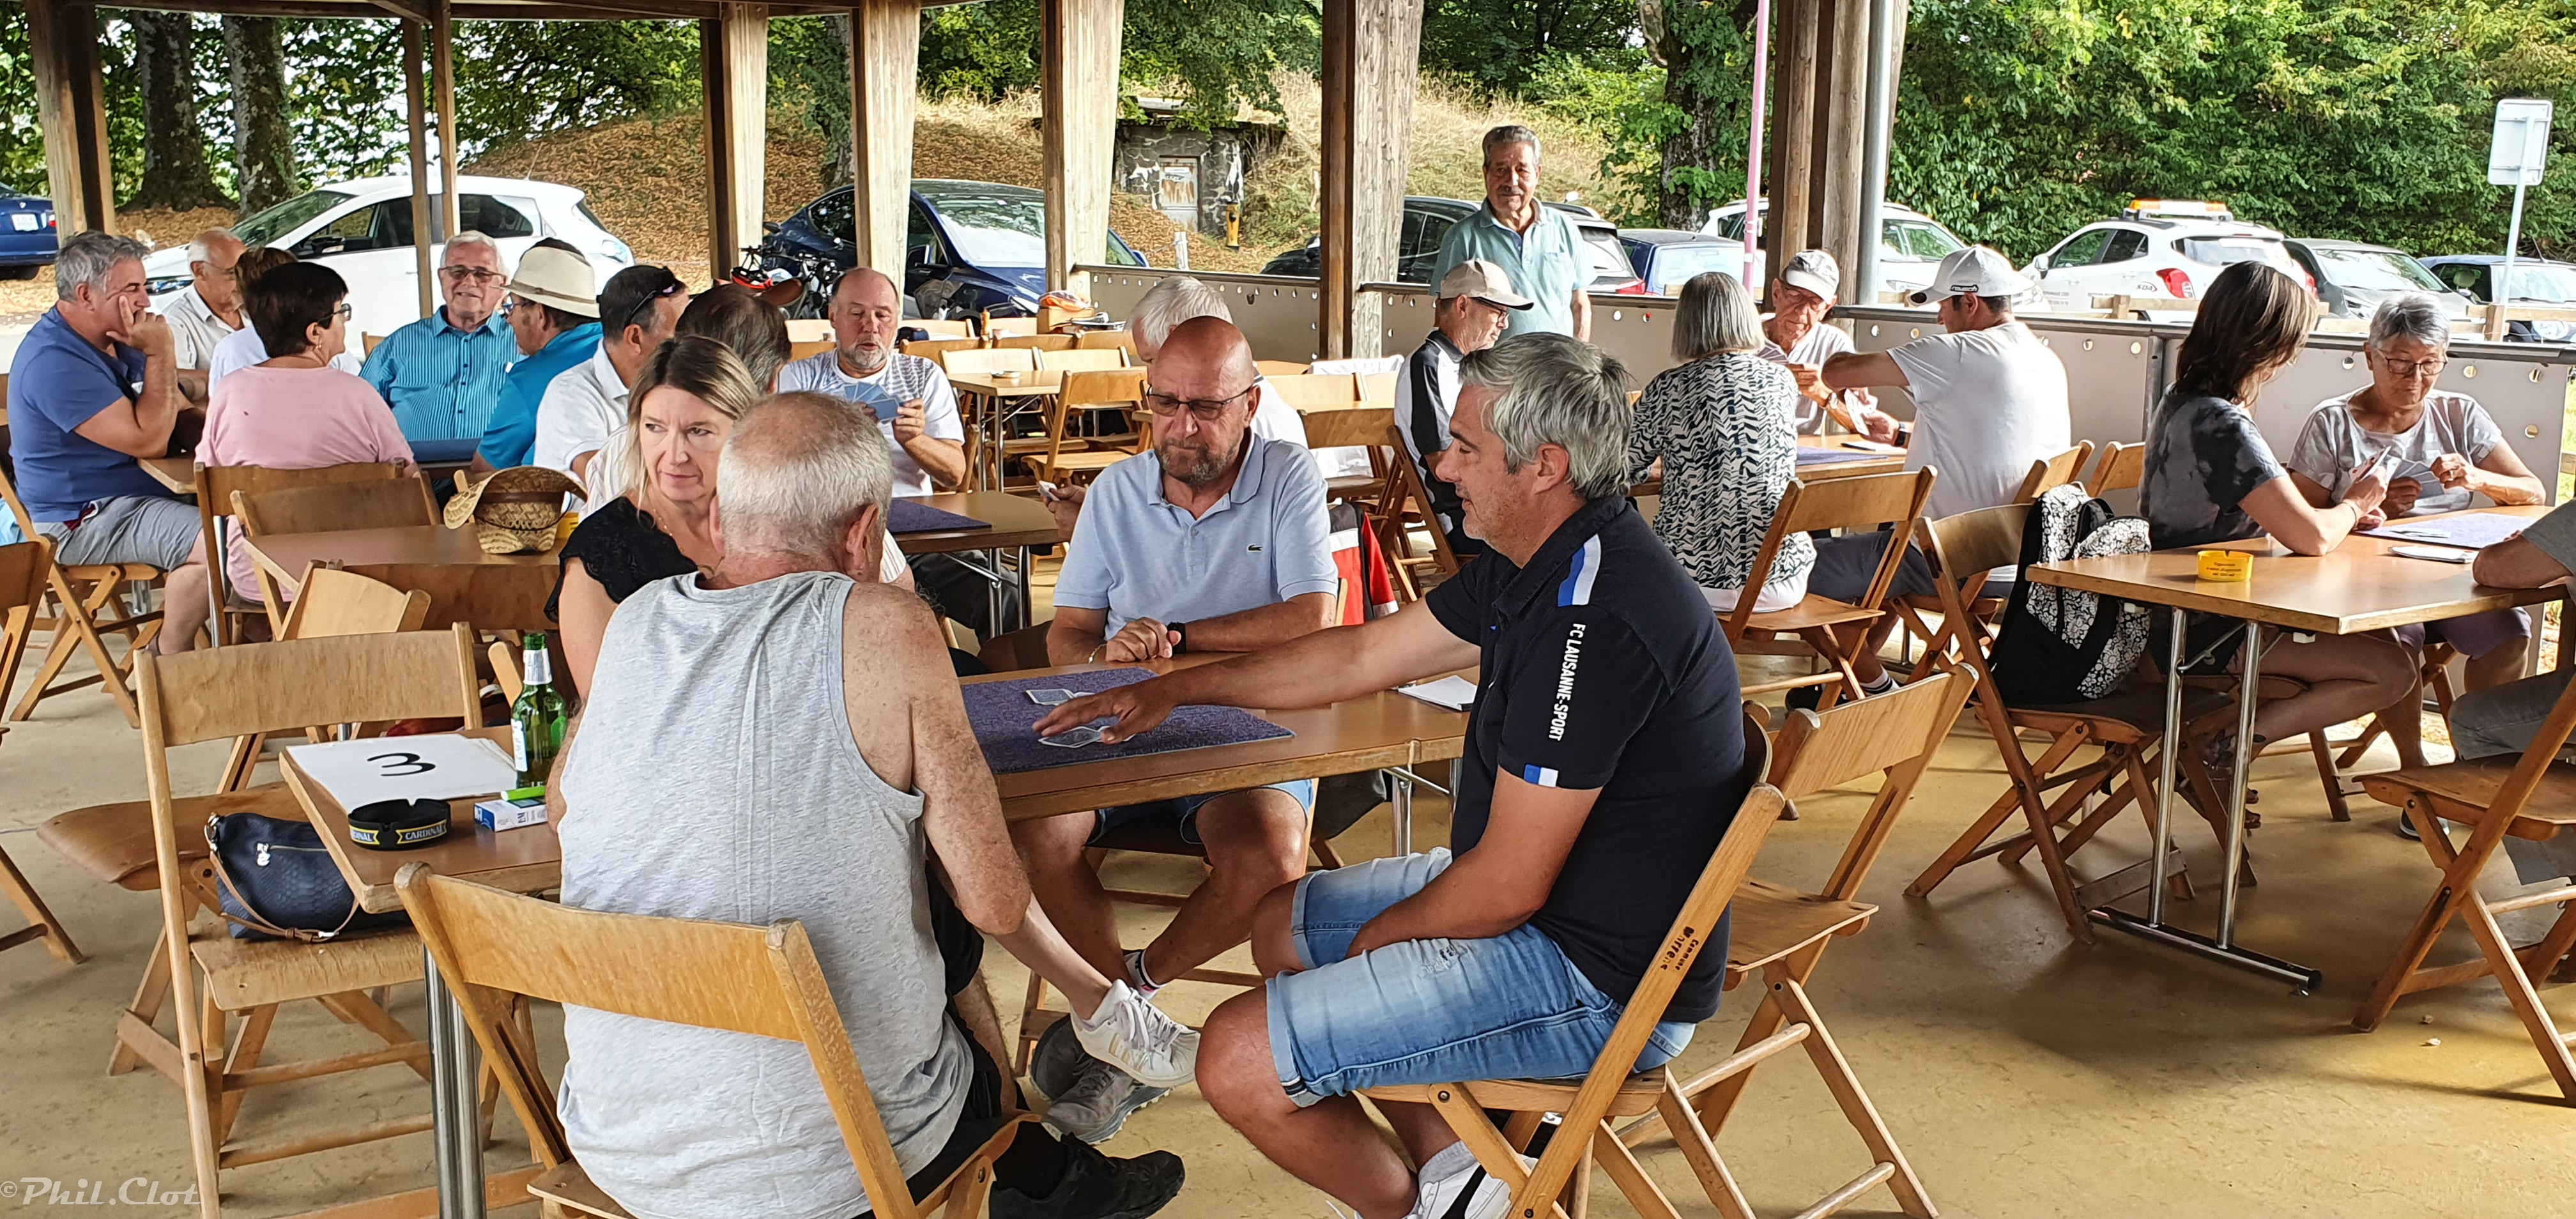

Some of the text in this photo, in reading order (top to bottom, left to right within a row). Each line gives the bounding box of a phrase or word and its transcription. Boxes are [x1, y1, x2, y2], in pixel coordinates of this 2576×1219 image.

[1549, 623, 1586, 742] FC LAUSANNE-SPORT
[367, 753, 436, 777] 3
[405, 825, 443, 841] CARDINAL
[1675, 939, 1699, 971] Commune
